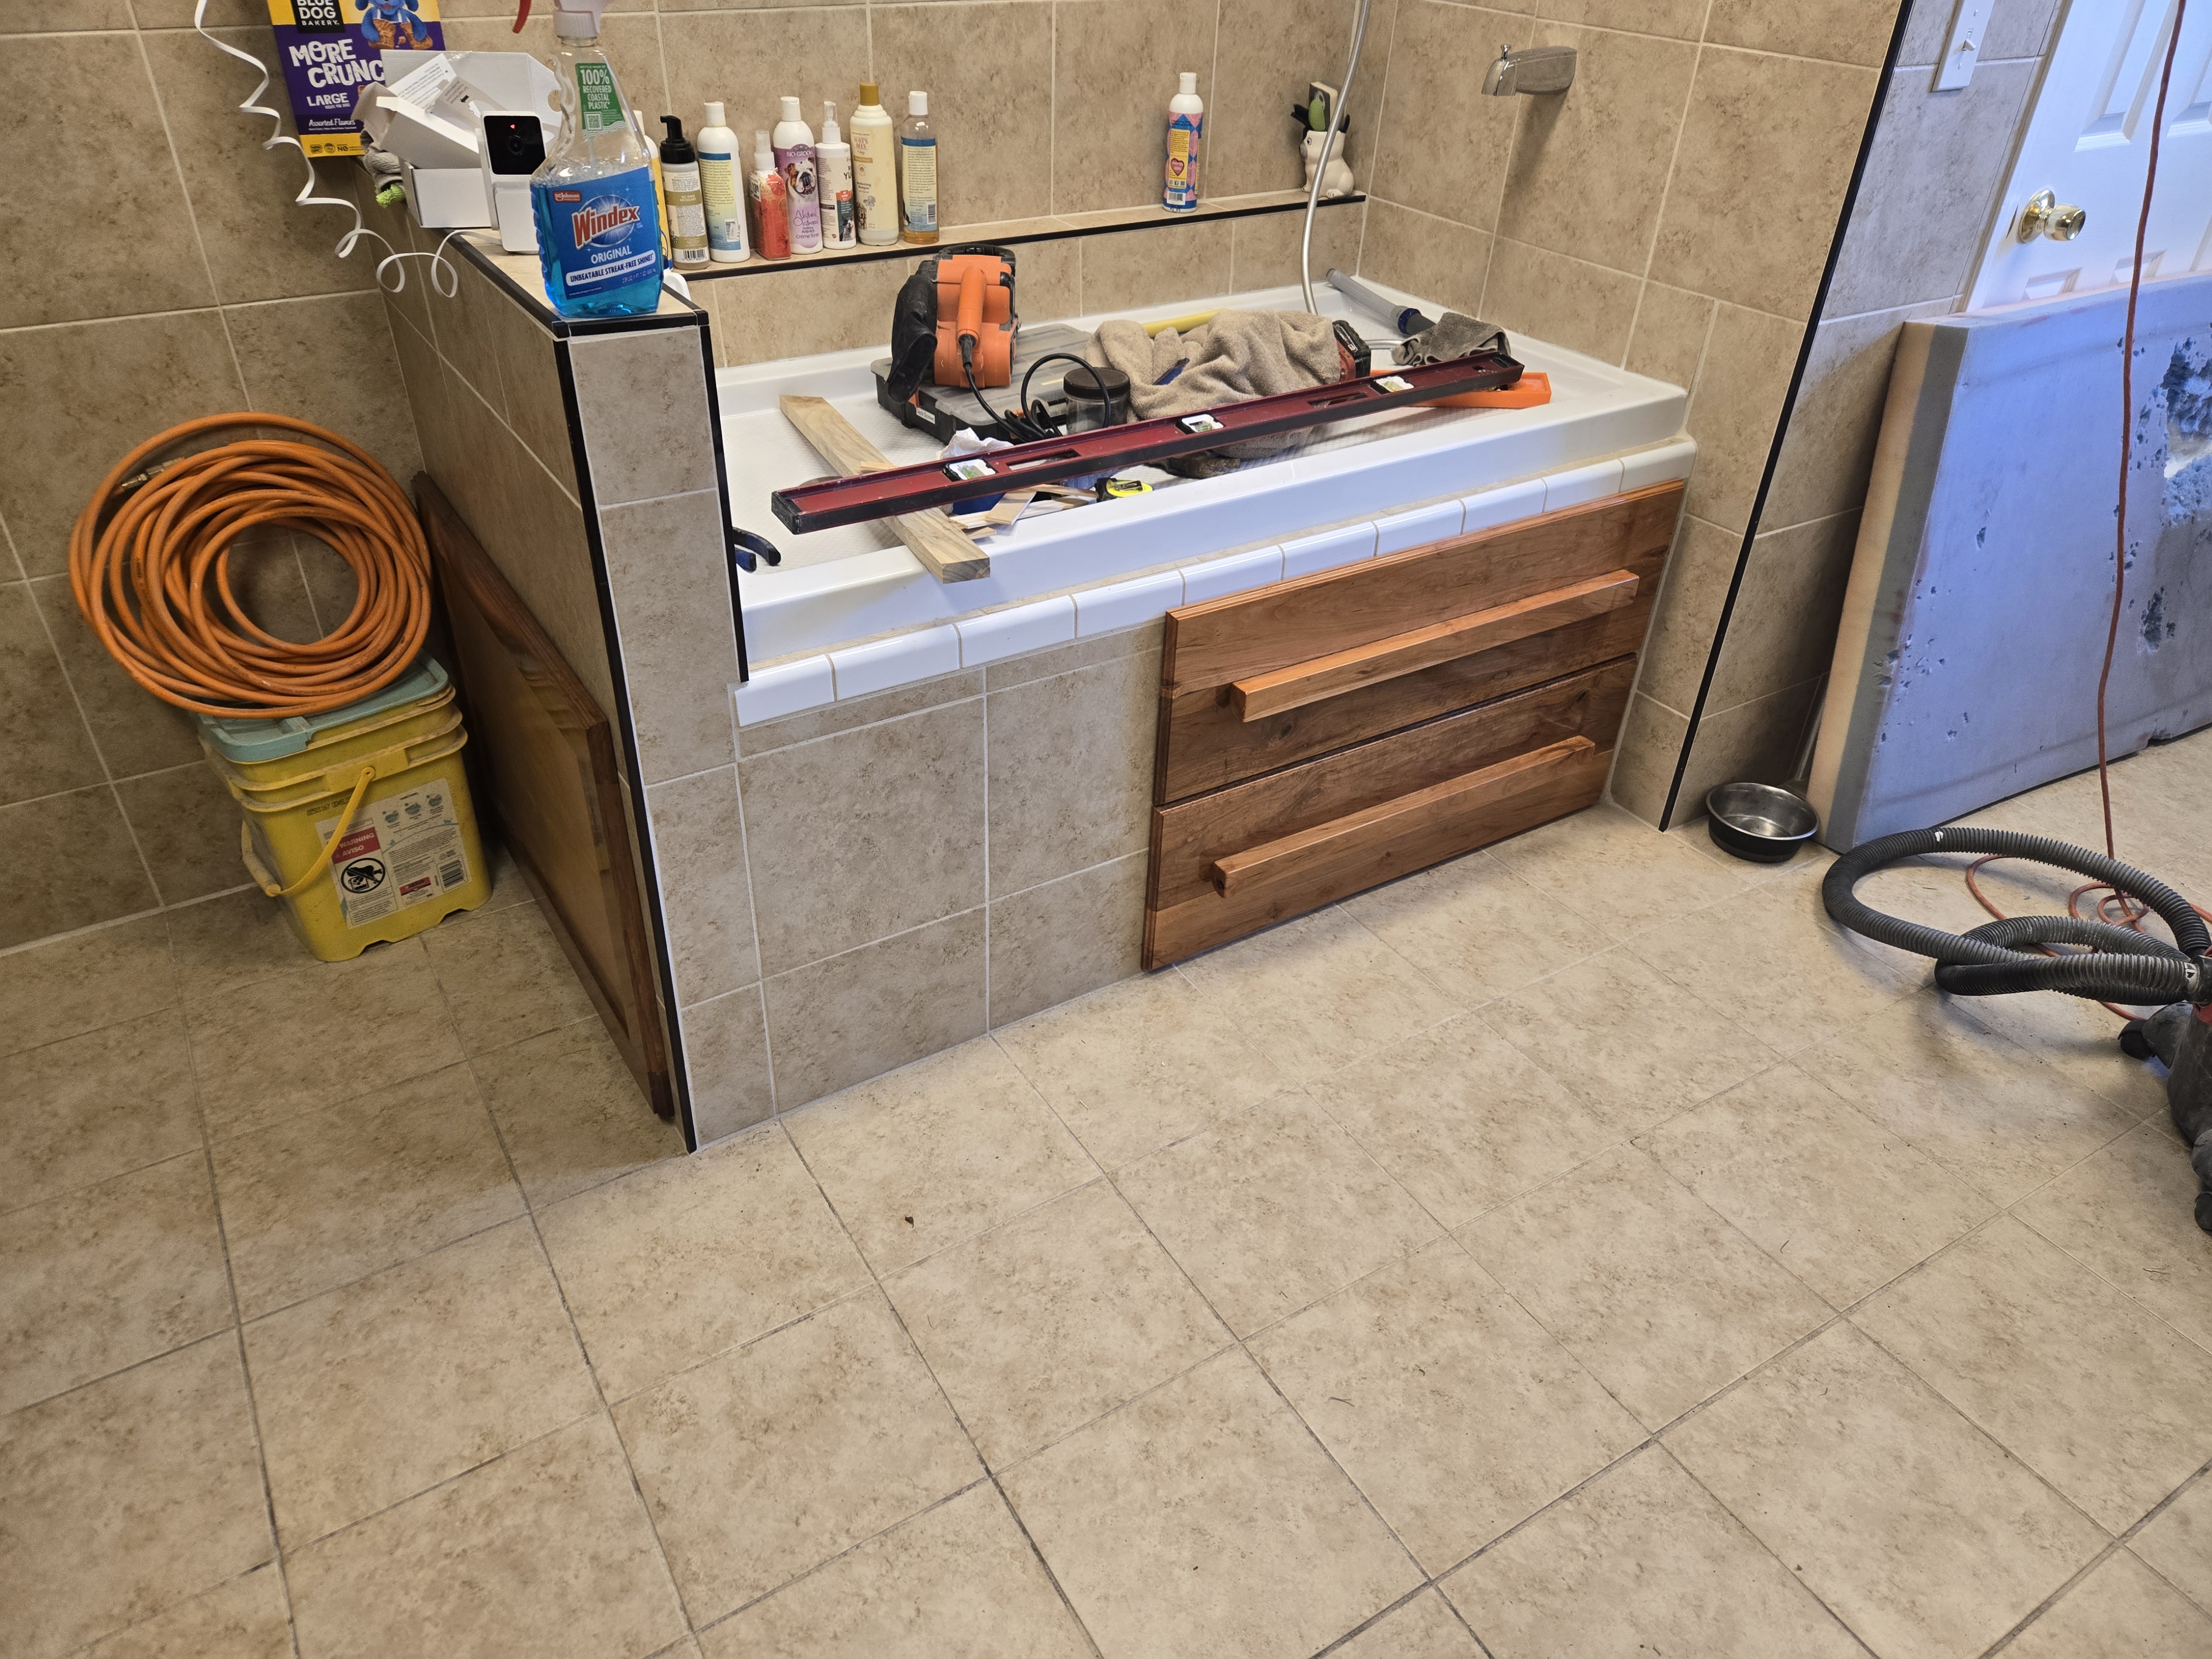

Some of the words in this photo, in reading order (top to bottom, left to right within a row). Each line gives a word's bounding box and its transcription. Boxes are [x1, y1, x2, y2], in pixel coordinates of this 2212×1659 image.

[298, 7, 336, 19] DOG
[289, 39, 356, 66] MORE
[307, 59, 385, 87] CRUNC
[581, 69, 610, 85] 100%
[306, 92, 349, 107] LARGE
[334, 118, 356, 126] Flavors
[572, 204, 640, 250] Windex
[591, 245, 632, 264] ORIGINAL
[570, 269, 604, 283] UNBEATABLE
[605, 261, 637, 275] STREAK-FREE
[339, 833, 374, 848] WARNING
[342, 845, 364, 856] AVISO
